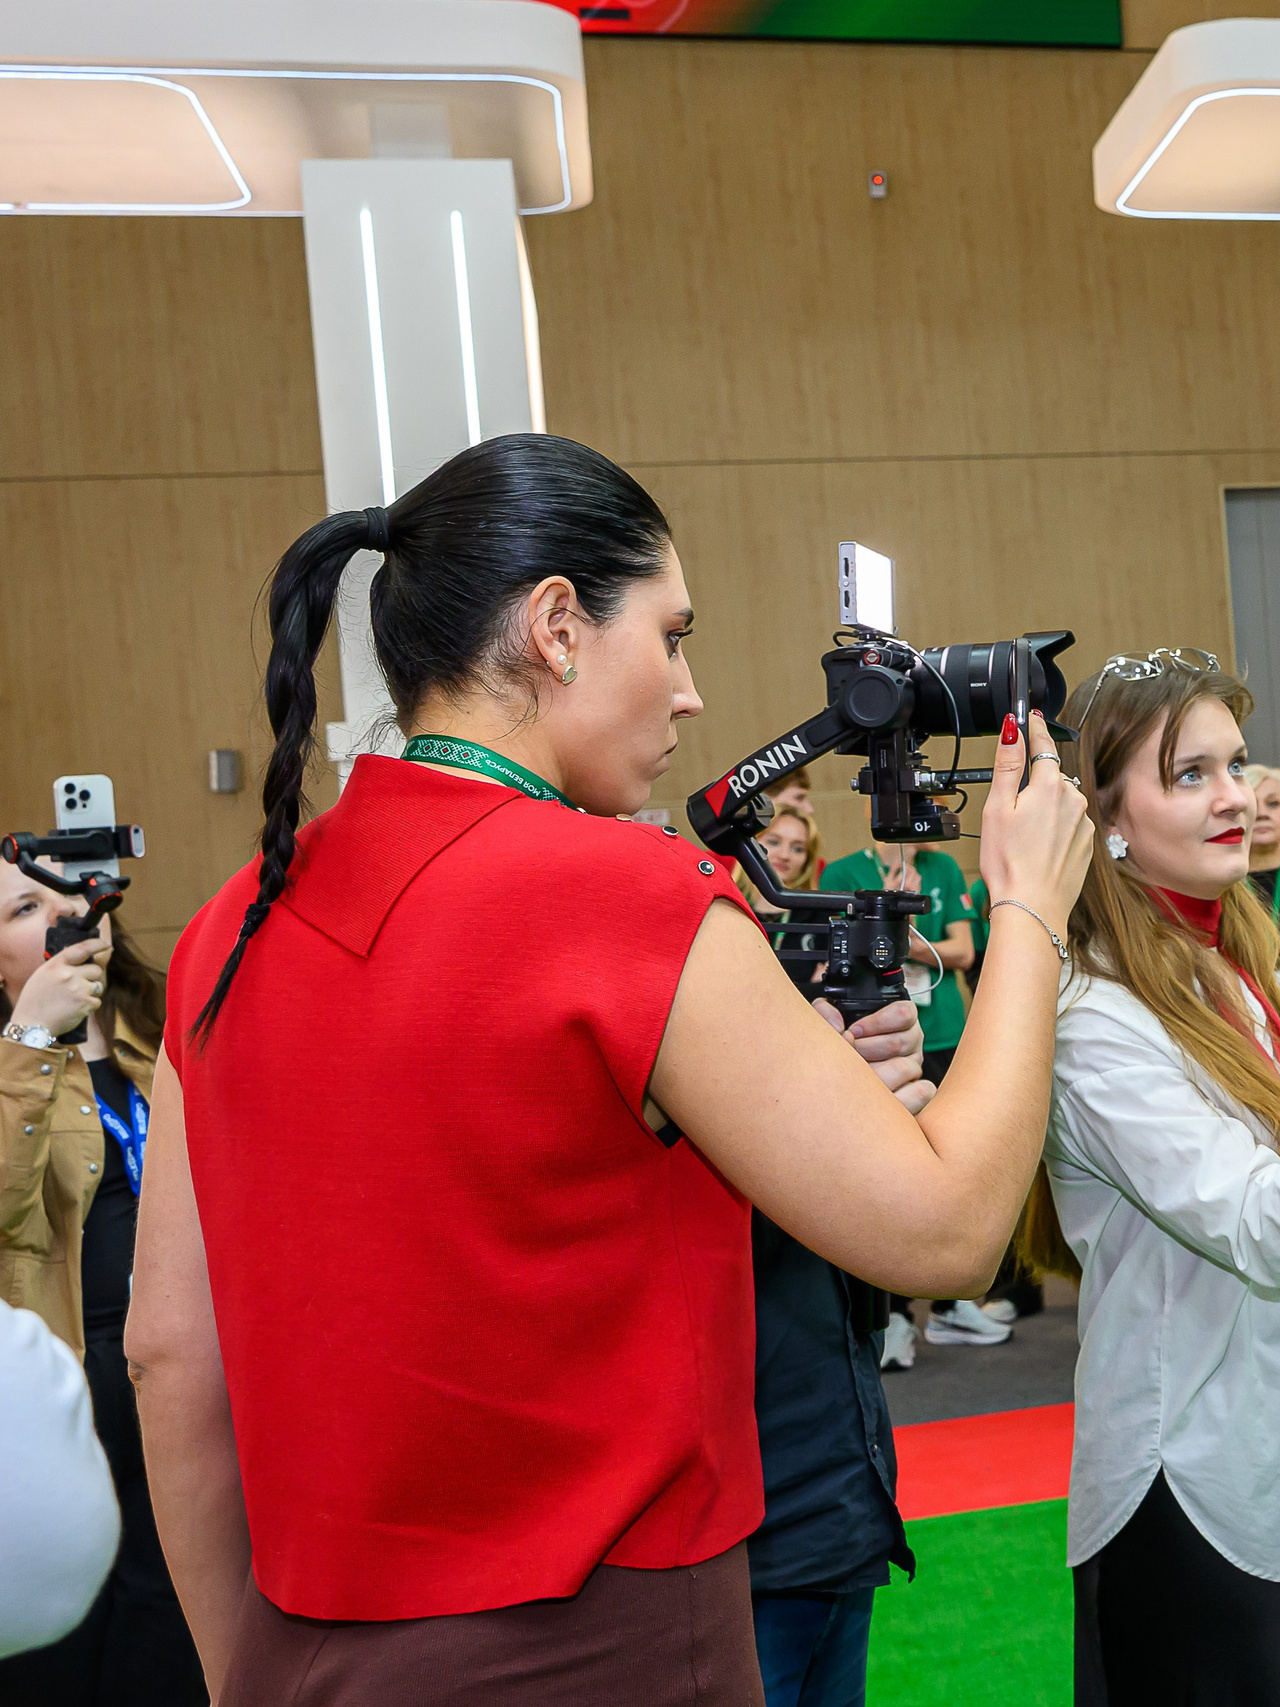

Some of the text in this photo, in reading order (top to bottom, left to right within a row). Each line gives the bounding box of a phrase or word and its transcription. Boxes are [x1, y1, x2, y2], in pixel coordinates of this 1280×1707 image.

[485, 759, 541, 797] МОЯ БЕЛАРУСЬ
[727, 734, 808, 798] RONIN
